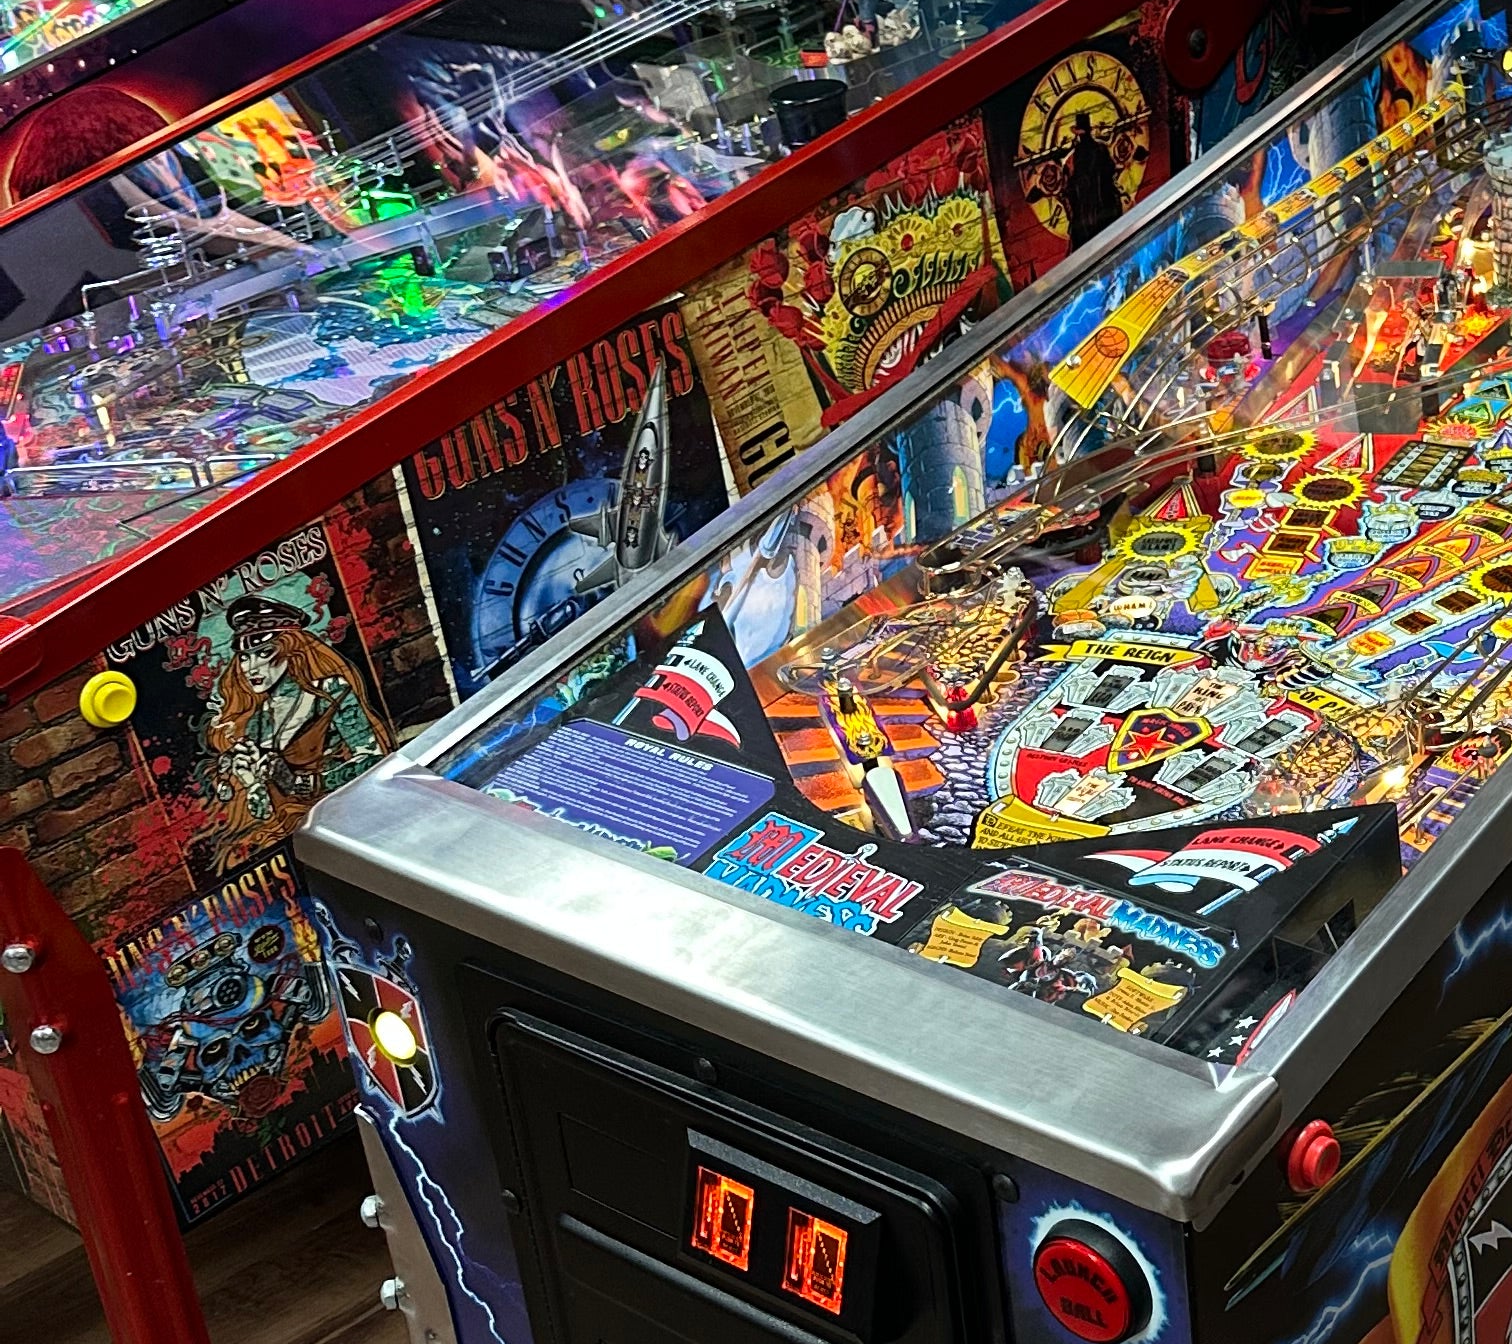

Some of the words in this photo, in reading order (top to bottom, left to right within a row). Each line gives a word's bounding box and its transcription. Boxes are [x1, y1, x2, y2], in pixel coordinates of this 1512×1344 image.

[413, 393, 528, 500] GUNS
[566, 311, 694, 437] ROSES
[484, 493, 572, 597] GUNS
[107, 597, 196, 663] GUNS
[234, 527, 327, 595] ROSES
[1084, 644, 1117, 655] THE
[1125, 648, 1176, 662] REIGN
[1299, 690, 1320, 704] OF
[624, 738, 666, 757] ROYAL
[668, 752, 714, 772] RULES
[981, 828, 999, 837] AND
[1192, 836, 1229, 846] LANE
[1230, 836, 1278, 849] CHANGE
[717, 815, 922, 922] MEDIEVAL
[1160, 858, 1202, 868] STATUS
[1203, 859, 1244, 872] REPORT
[202, 854, 297, 934] ROSES
[969, 870, 1118, 920] MEDIEVAL
[1110, 900, 1226, 968] MADNESS
[229, 1105, 338, 1195] DETROIT
[1040, 1257, 1118, 1304] LAUNCH
[1060, 1296, 1108, 1329] BALL
